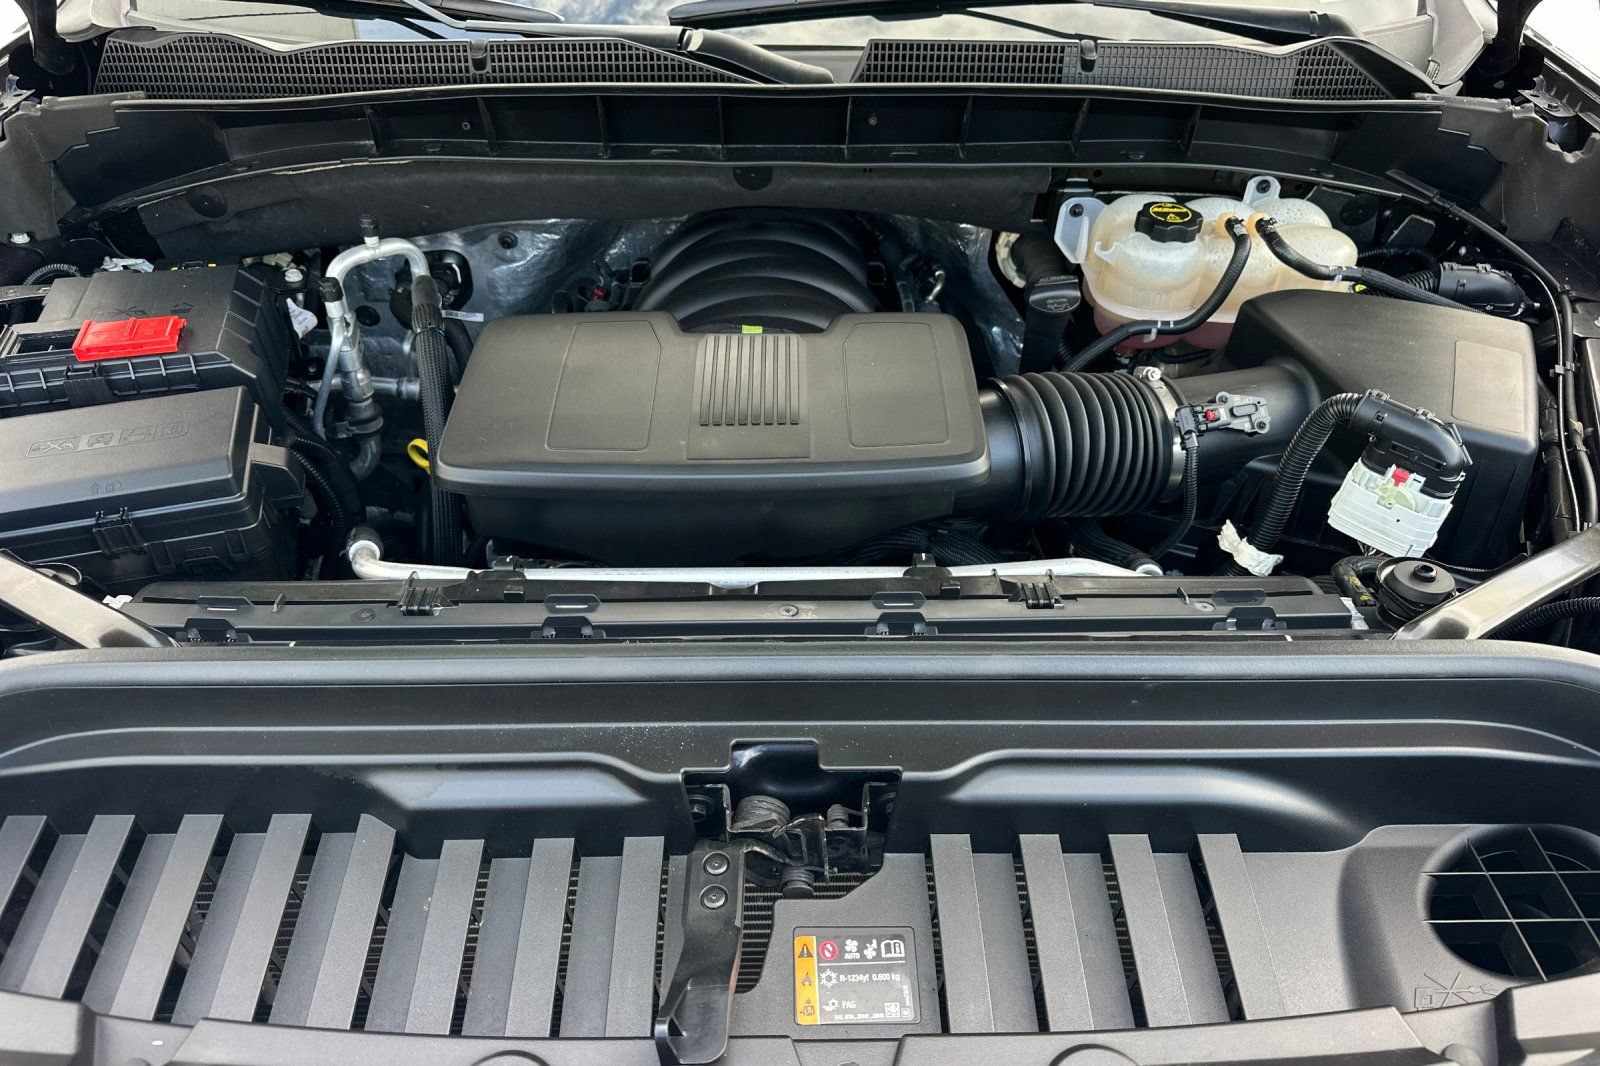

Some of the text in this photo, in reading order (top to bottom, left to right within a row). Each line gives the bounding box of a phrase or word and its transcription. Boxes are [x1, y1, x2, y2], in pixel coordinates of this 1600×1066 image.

[839, 972, 900, 982] R-1234yf 0.600 kg
[842, 1000, 856, 1009] PAG
